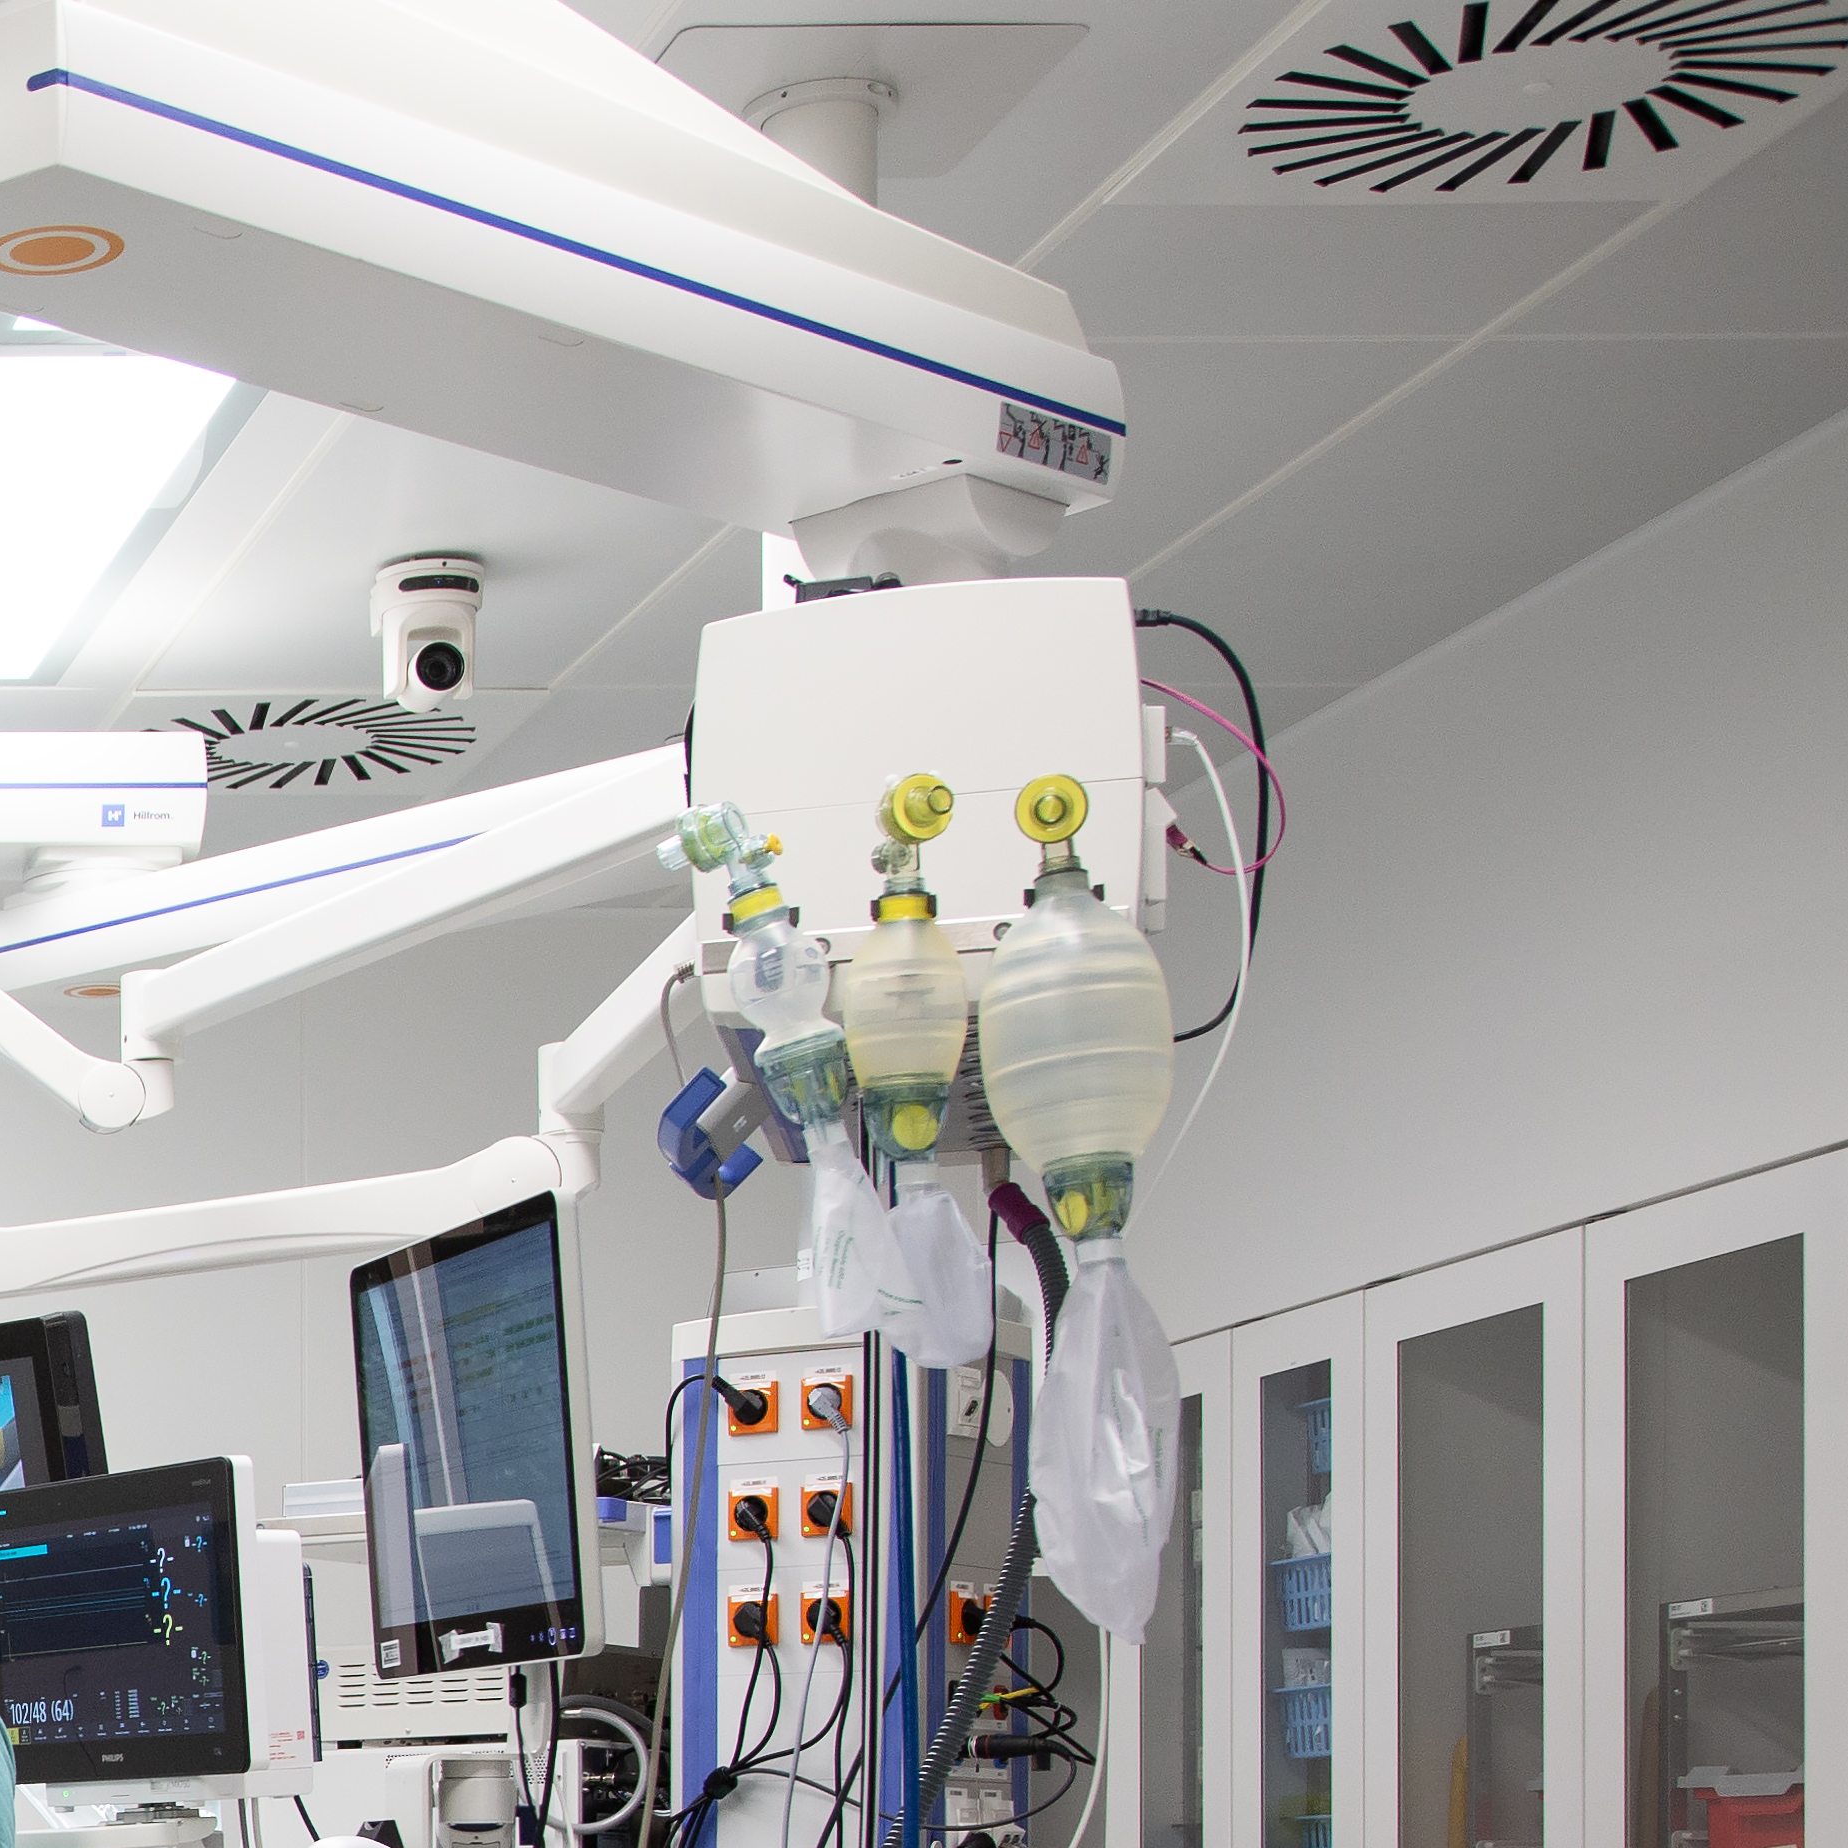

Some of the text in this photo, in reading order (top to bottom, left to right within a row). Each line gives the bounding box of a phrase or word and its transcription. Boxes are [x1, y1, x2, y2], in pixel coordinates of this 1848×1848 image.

[10, 1699, 75, 1725] 102/48 (64)
[101, 1753, 124, 1763] PHILIPS
